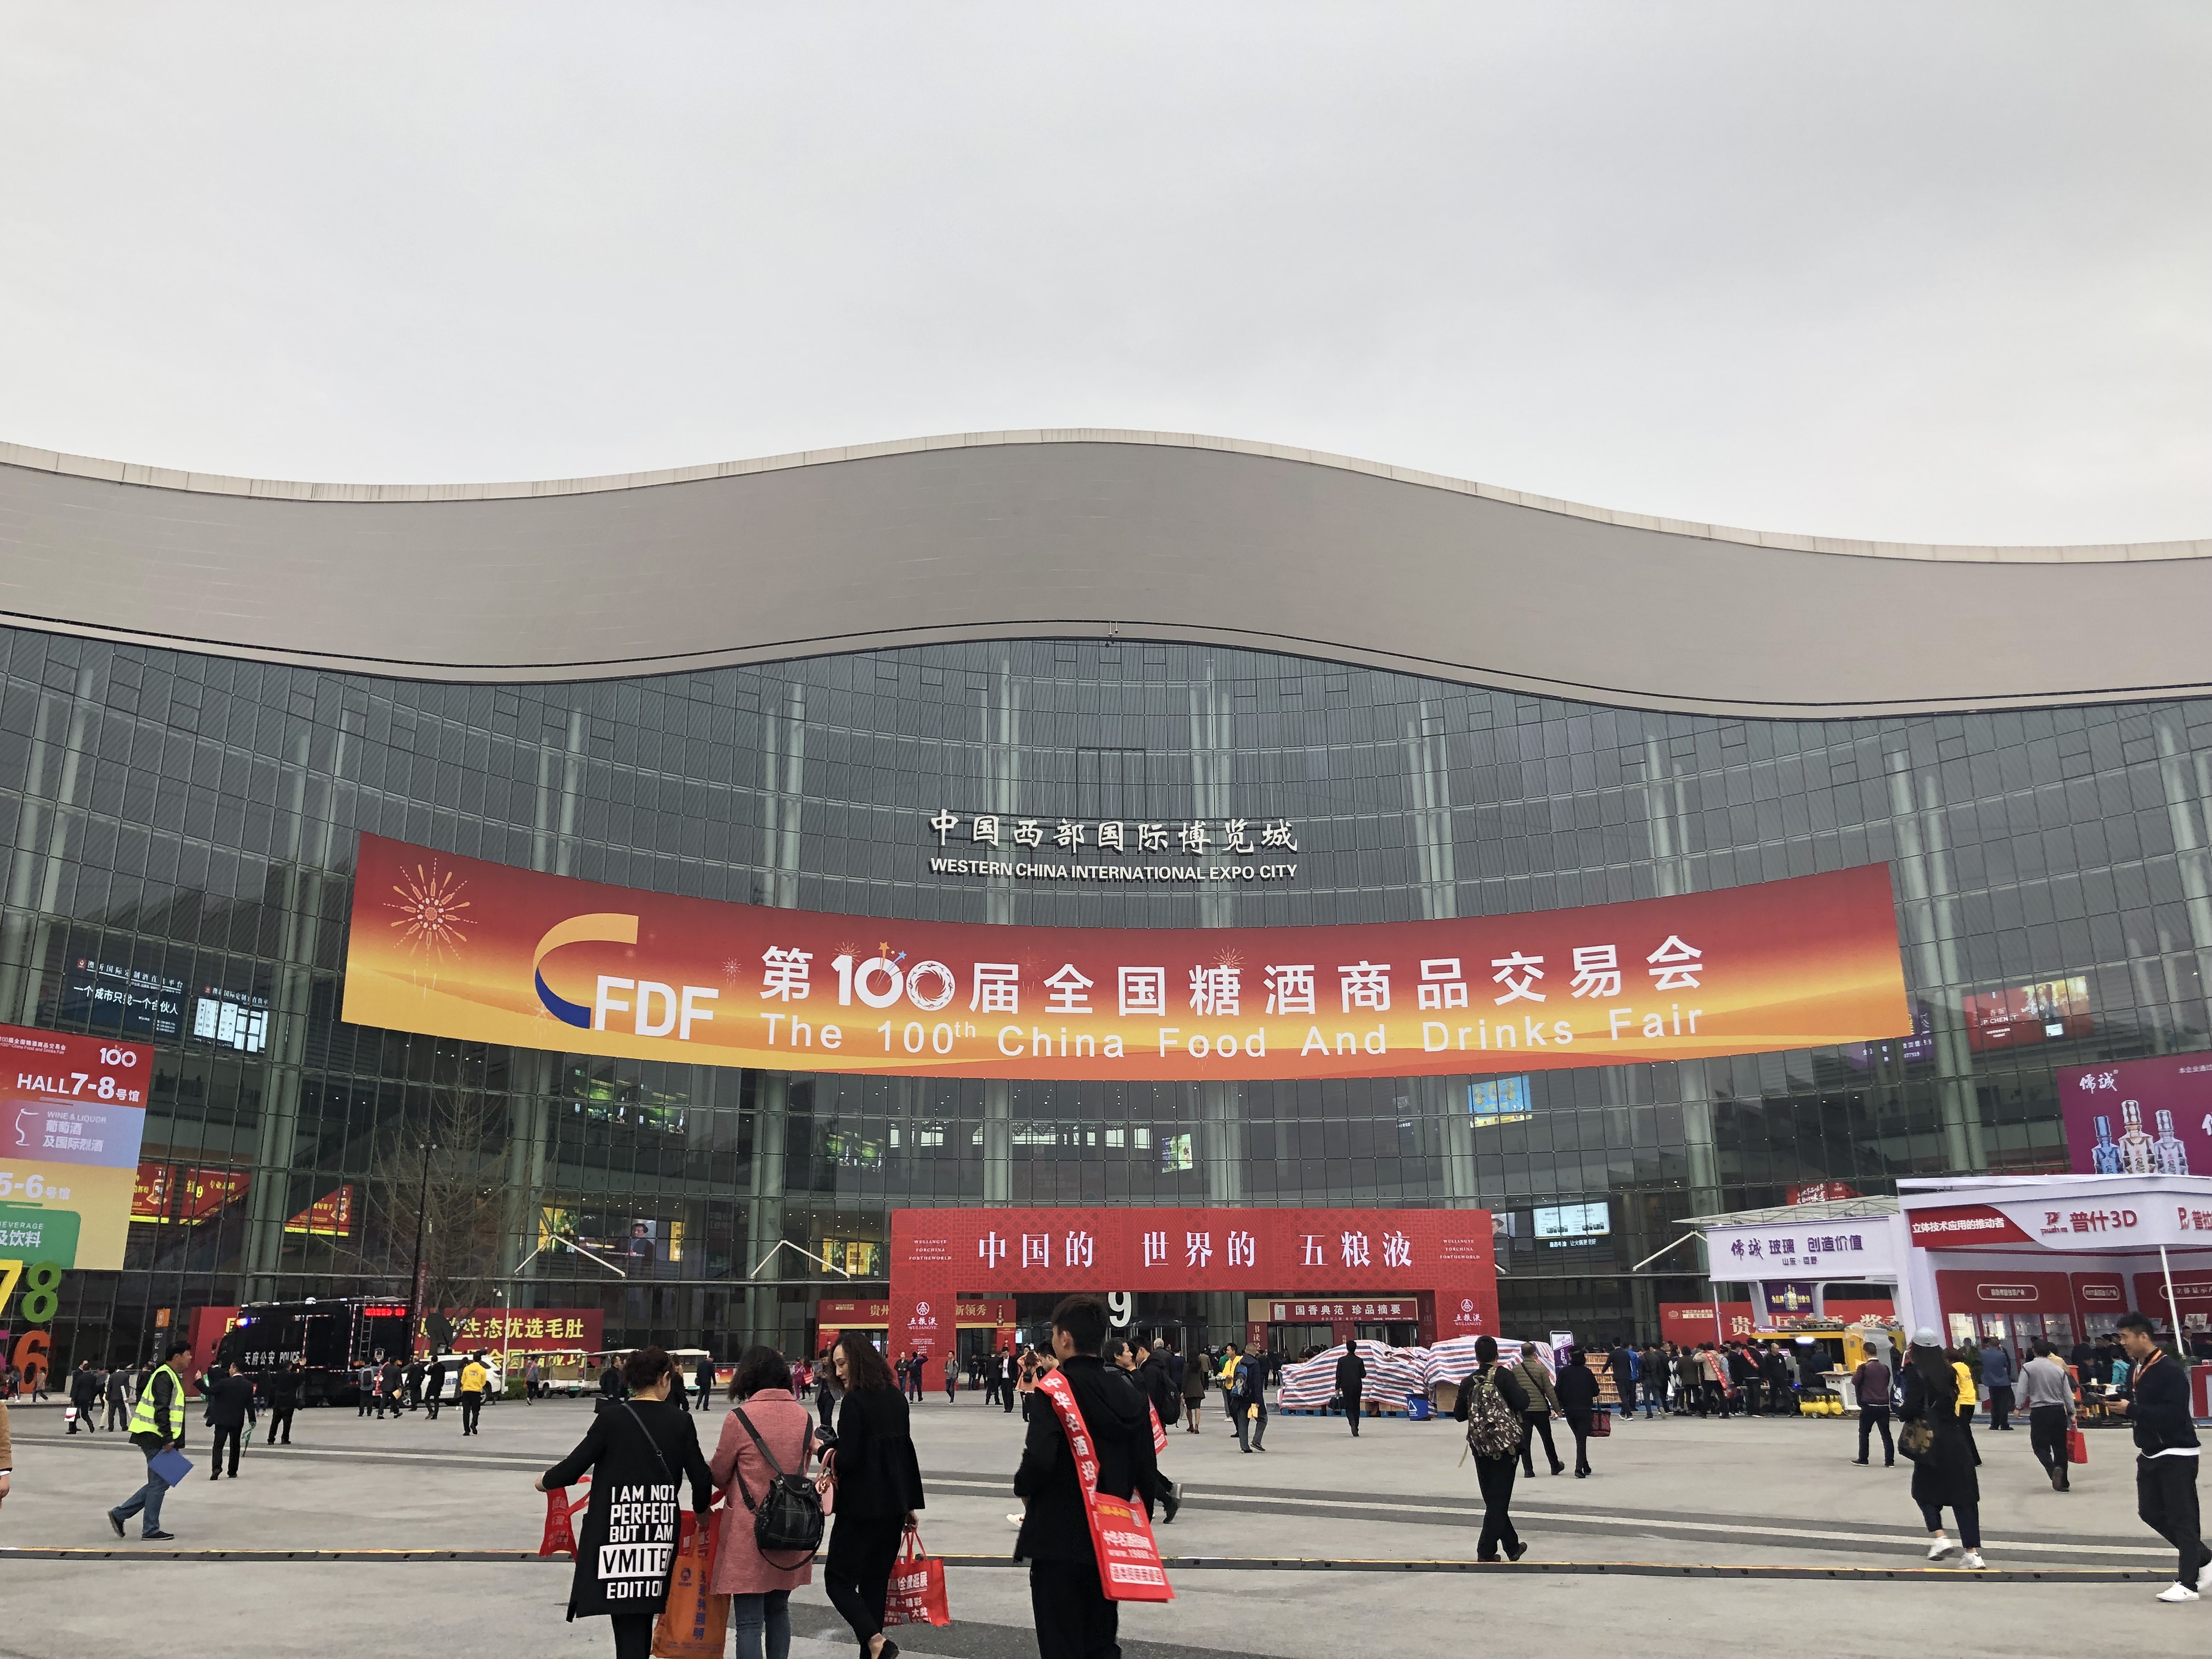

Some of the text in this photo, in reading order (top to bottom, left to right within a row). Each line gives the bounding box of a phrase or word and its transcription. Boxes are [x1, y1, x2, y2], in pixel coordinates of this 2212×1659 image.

[930, 809, 1297, 854] 中国西部国际博览城
[931, 858, 1297, 880] WESTERN CHINA INTERNATIONAL EXPO CITY
[760, 1012, 842, 1049] The
[998, 1024, 1124, 1058] China
[1159, 1027, 1266, 1058] Food
[1300, 1024, 1386, 1057] And
[1422, 1015, 1574, 1053] Drinks
[1609, 1004, 1703, 1041] Fair
[100, 1047, 137, 1068] 100
[47, 1110, 67, 1120] WINE
[77, 1114, 107, 1124] LIQUOR
[46, 1120, 83, 1136] 葡萄酒
[43, 1135, 104, 1152] 及国际烈酒
[0, 1221, 43, 1230] EVERAGE
[1912, 1217, 2005, 1234] 立体技术应用的推动者
[2069, 1210, 2138, 1233] 普什3D
[978, 1230, 1413, 1269] 中国的 世界的 五粮液
[1769, 1238, 1795, 1254] 玻璃
[1807, 1234, 1864, 1252] 创造价值
[21, 1261, 62, 1323] 8
[1108, 1291, 1131, 1327] 9
[1295, 1304, 1401, 1316] 国香典范 珍品摘要
[12, 1330, 50, 1393] 6
[245, 1351, 276, 1366] 天府公安
[279, 1351, 300, 1364] POLICE
[611, 1485, 675, 1503] I AM NOT
[610, 1525, 674, 1543] BUT I AM
